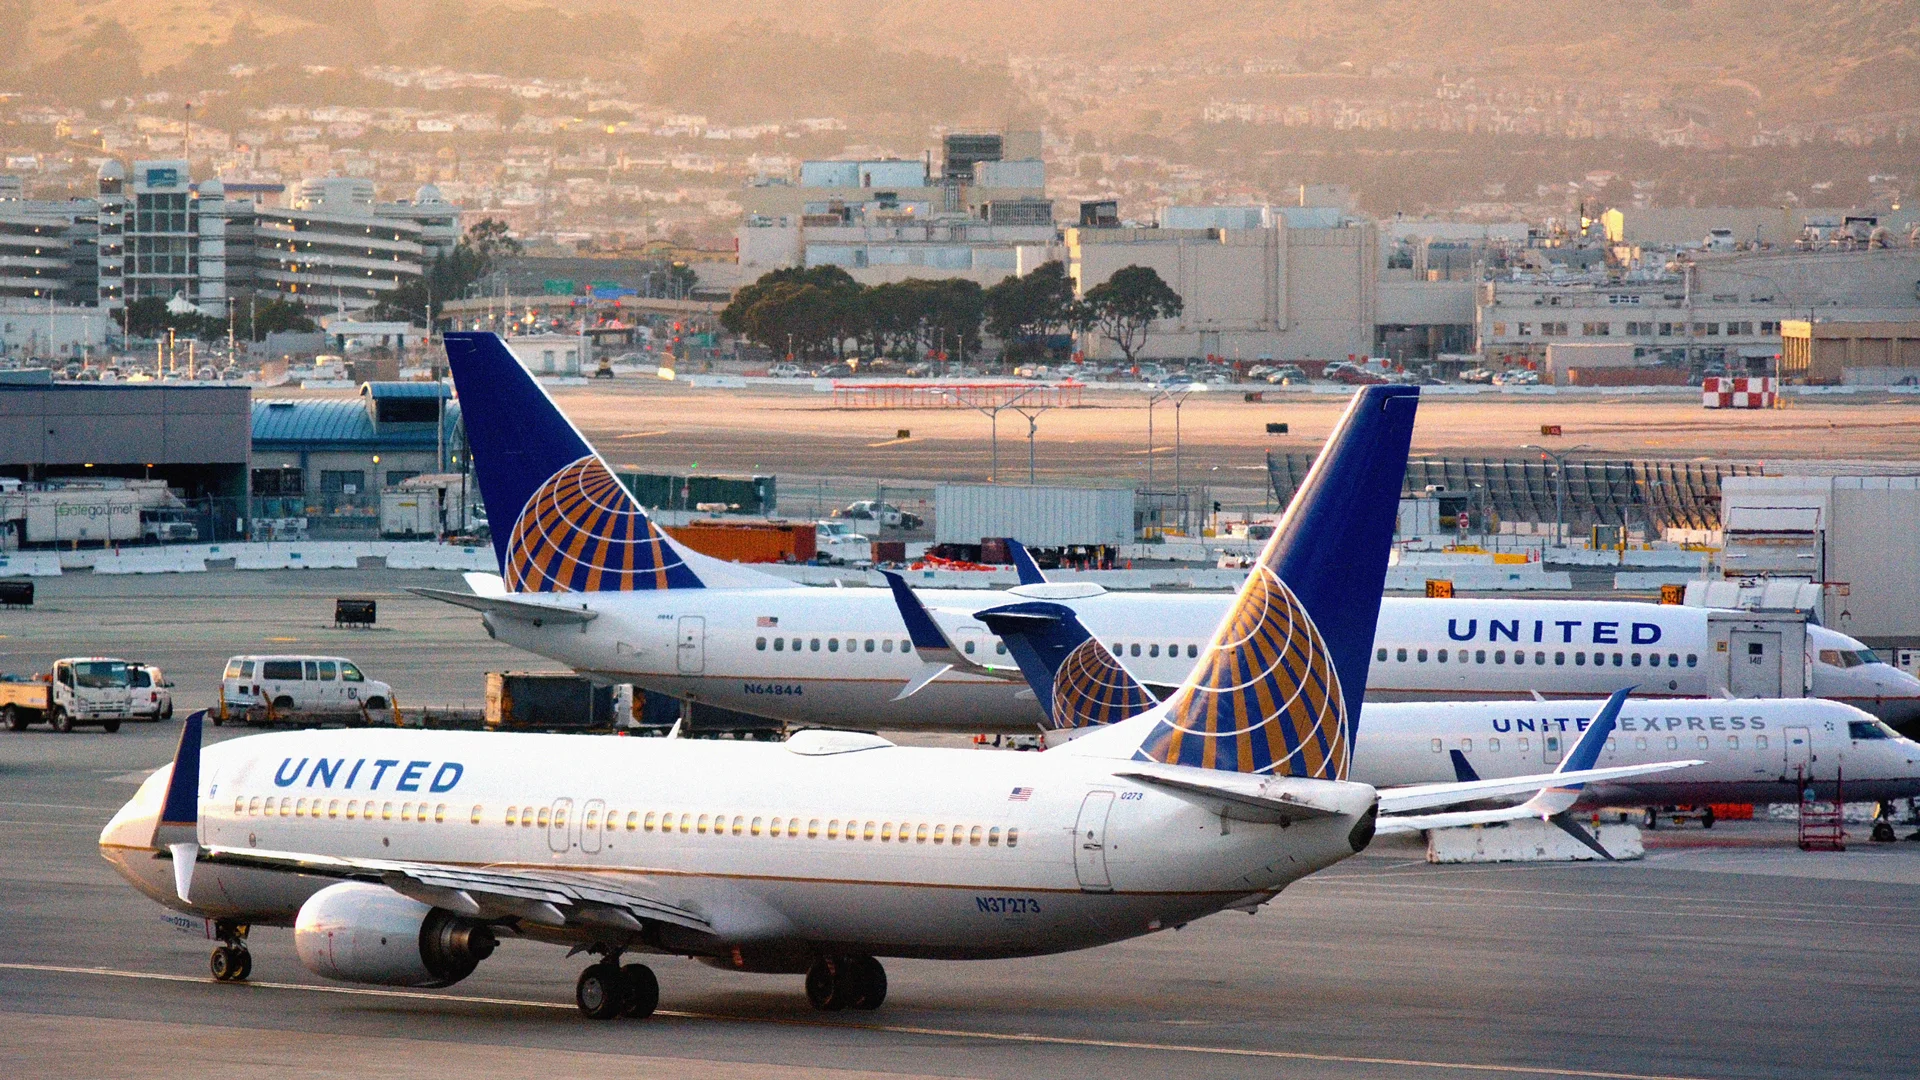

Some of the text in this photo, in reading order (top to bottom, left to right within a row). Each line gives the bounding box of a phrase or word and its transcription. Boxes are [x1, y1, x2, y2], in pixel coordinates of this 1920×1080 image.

[1448, 619, 1662, 645] UNITED
[744, 683, 803, 696] N64844
[1492, 716, 1766, 733] UNITE EXPRESS
[274, 758, 464, 794] UNITED
[1121, 792, 1143, 801] 0273
[975, 896, 1041, 914] N37273
